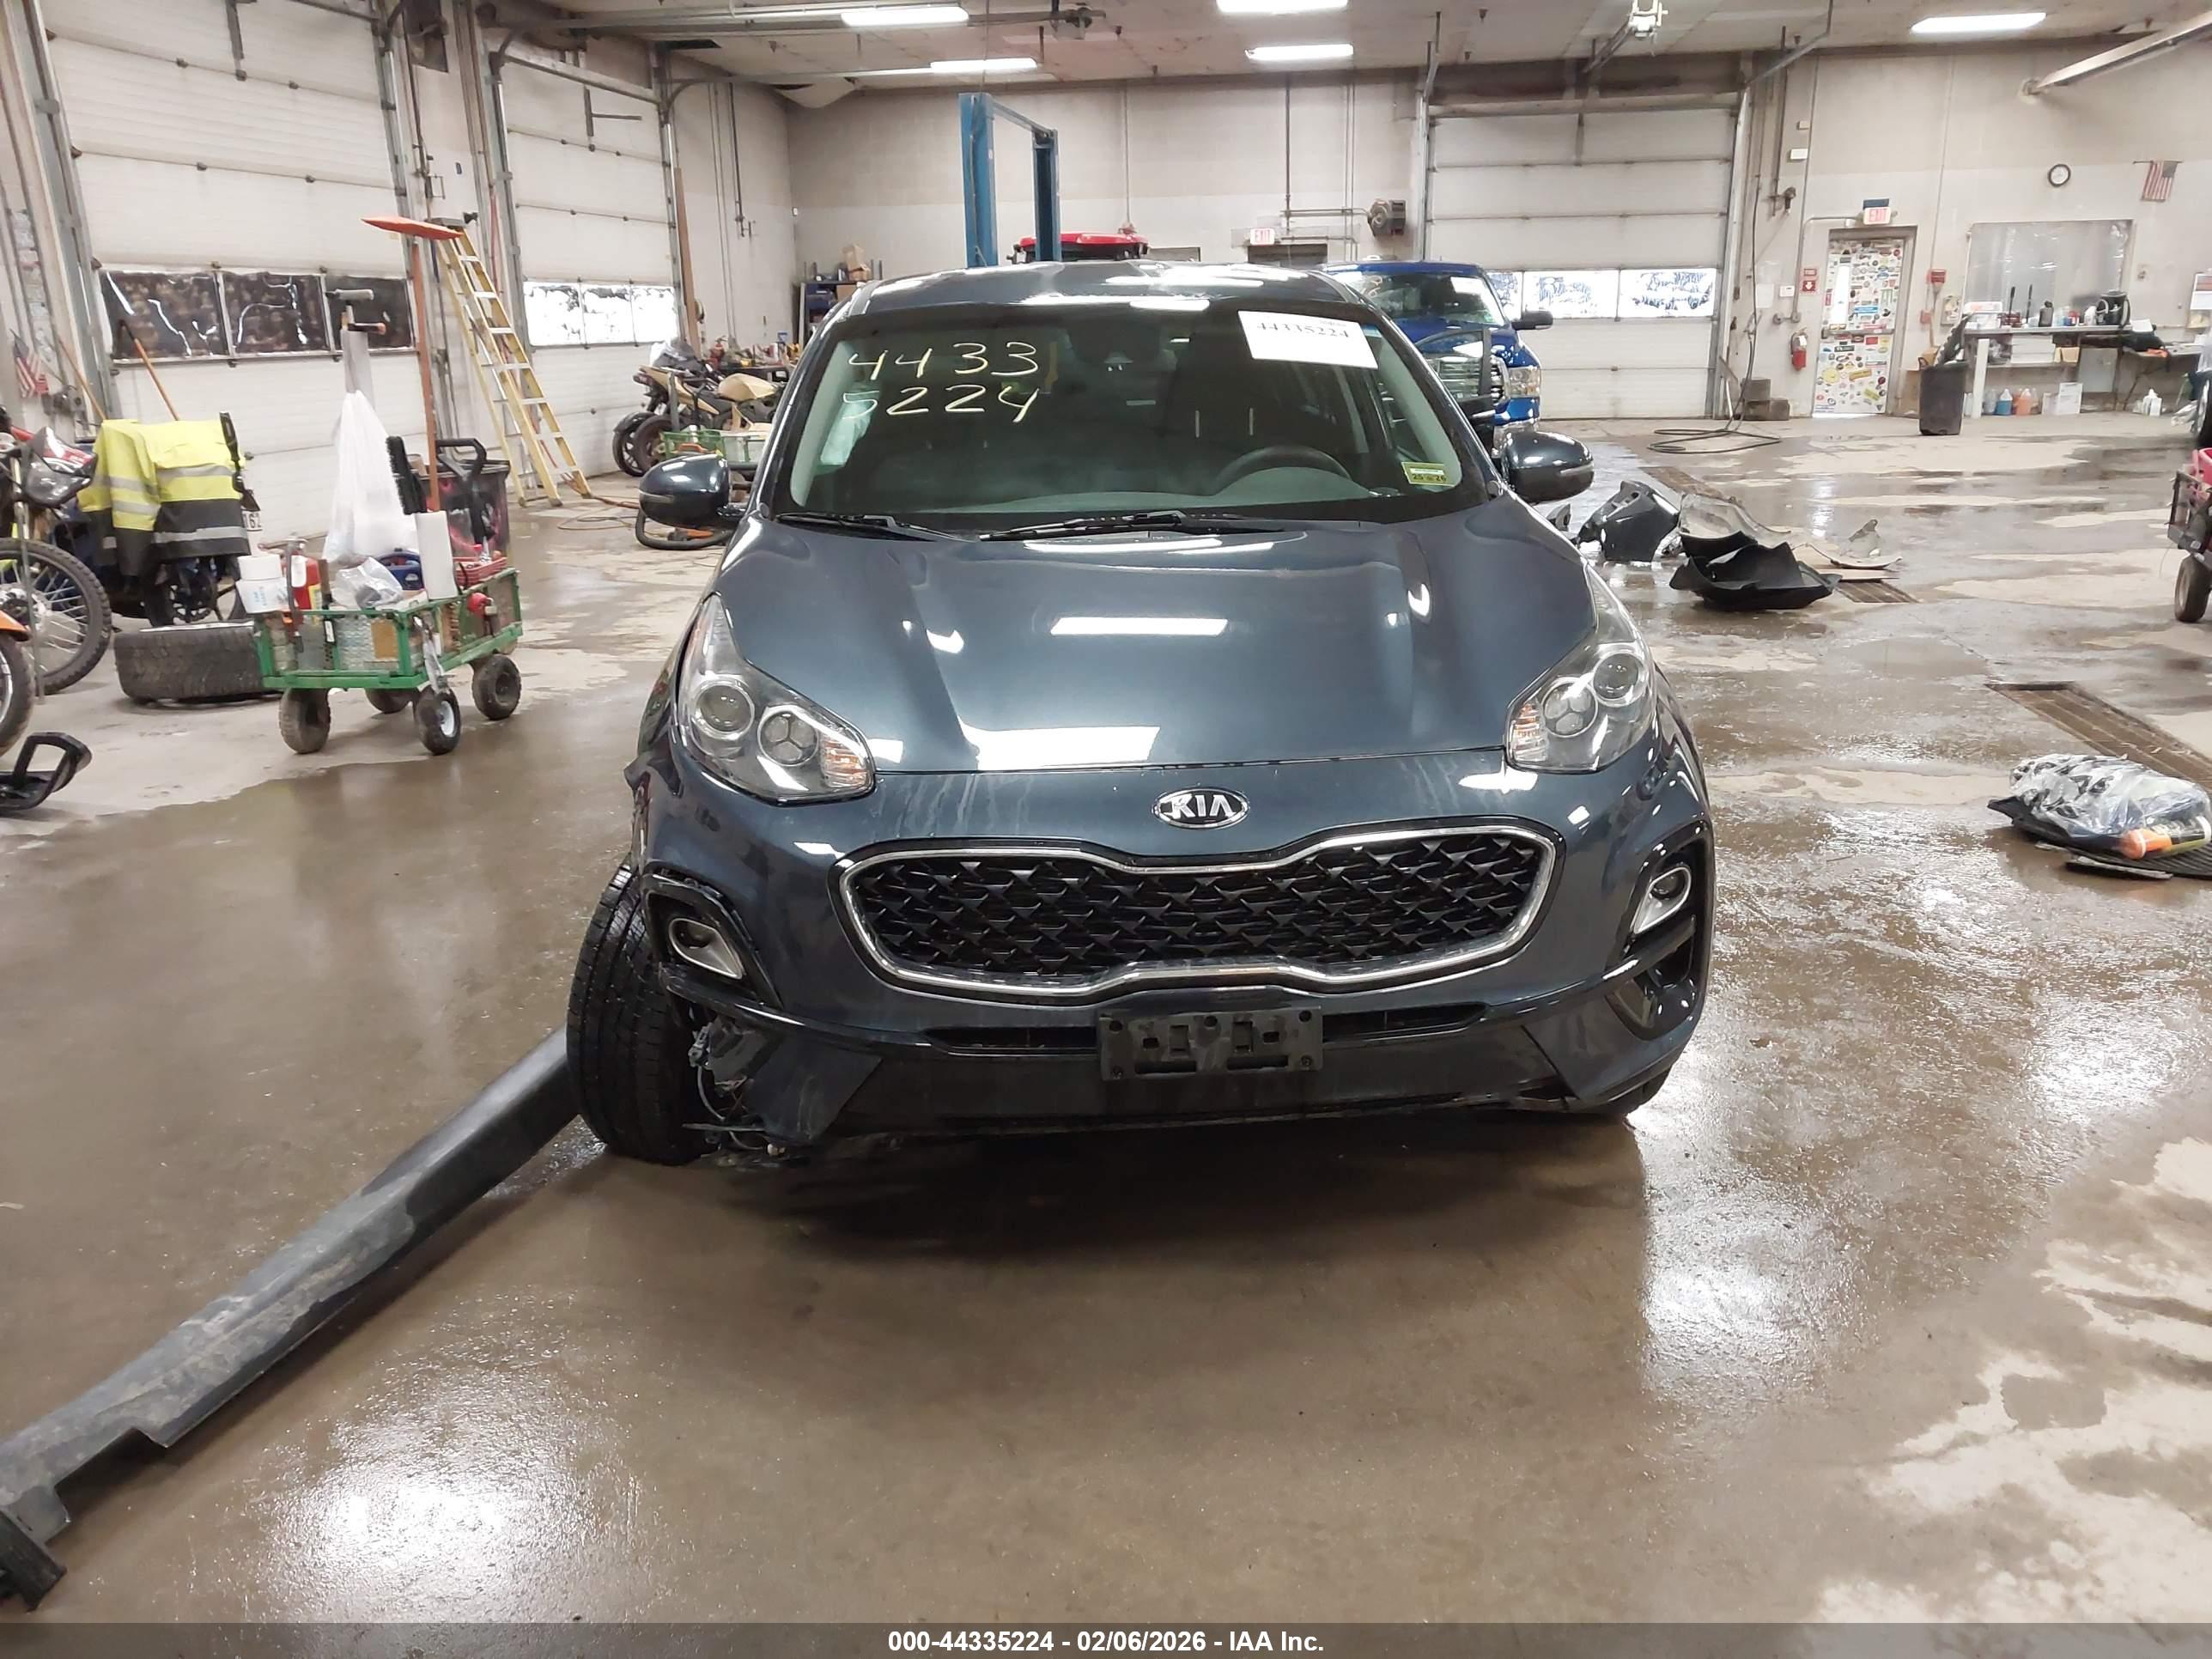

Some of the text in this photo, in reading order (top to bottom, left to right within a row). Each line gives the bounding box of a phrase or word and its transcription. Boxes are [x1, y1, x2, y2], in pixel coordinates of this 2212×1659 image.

[1256, 322, 1350, 338] 44335224
[848, 342, 1038, 380] 4433
[843, 384, 1039, 422] 5224
[1164, 793, 1237, 819] KIA
